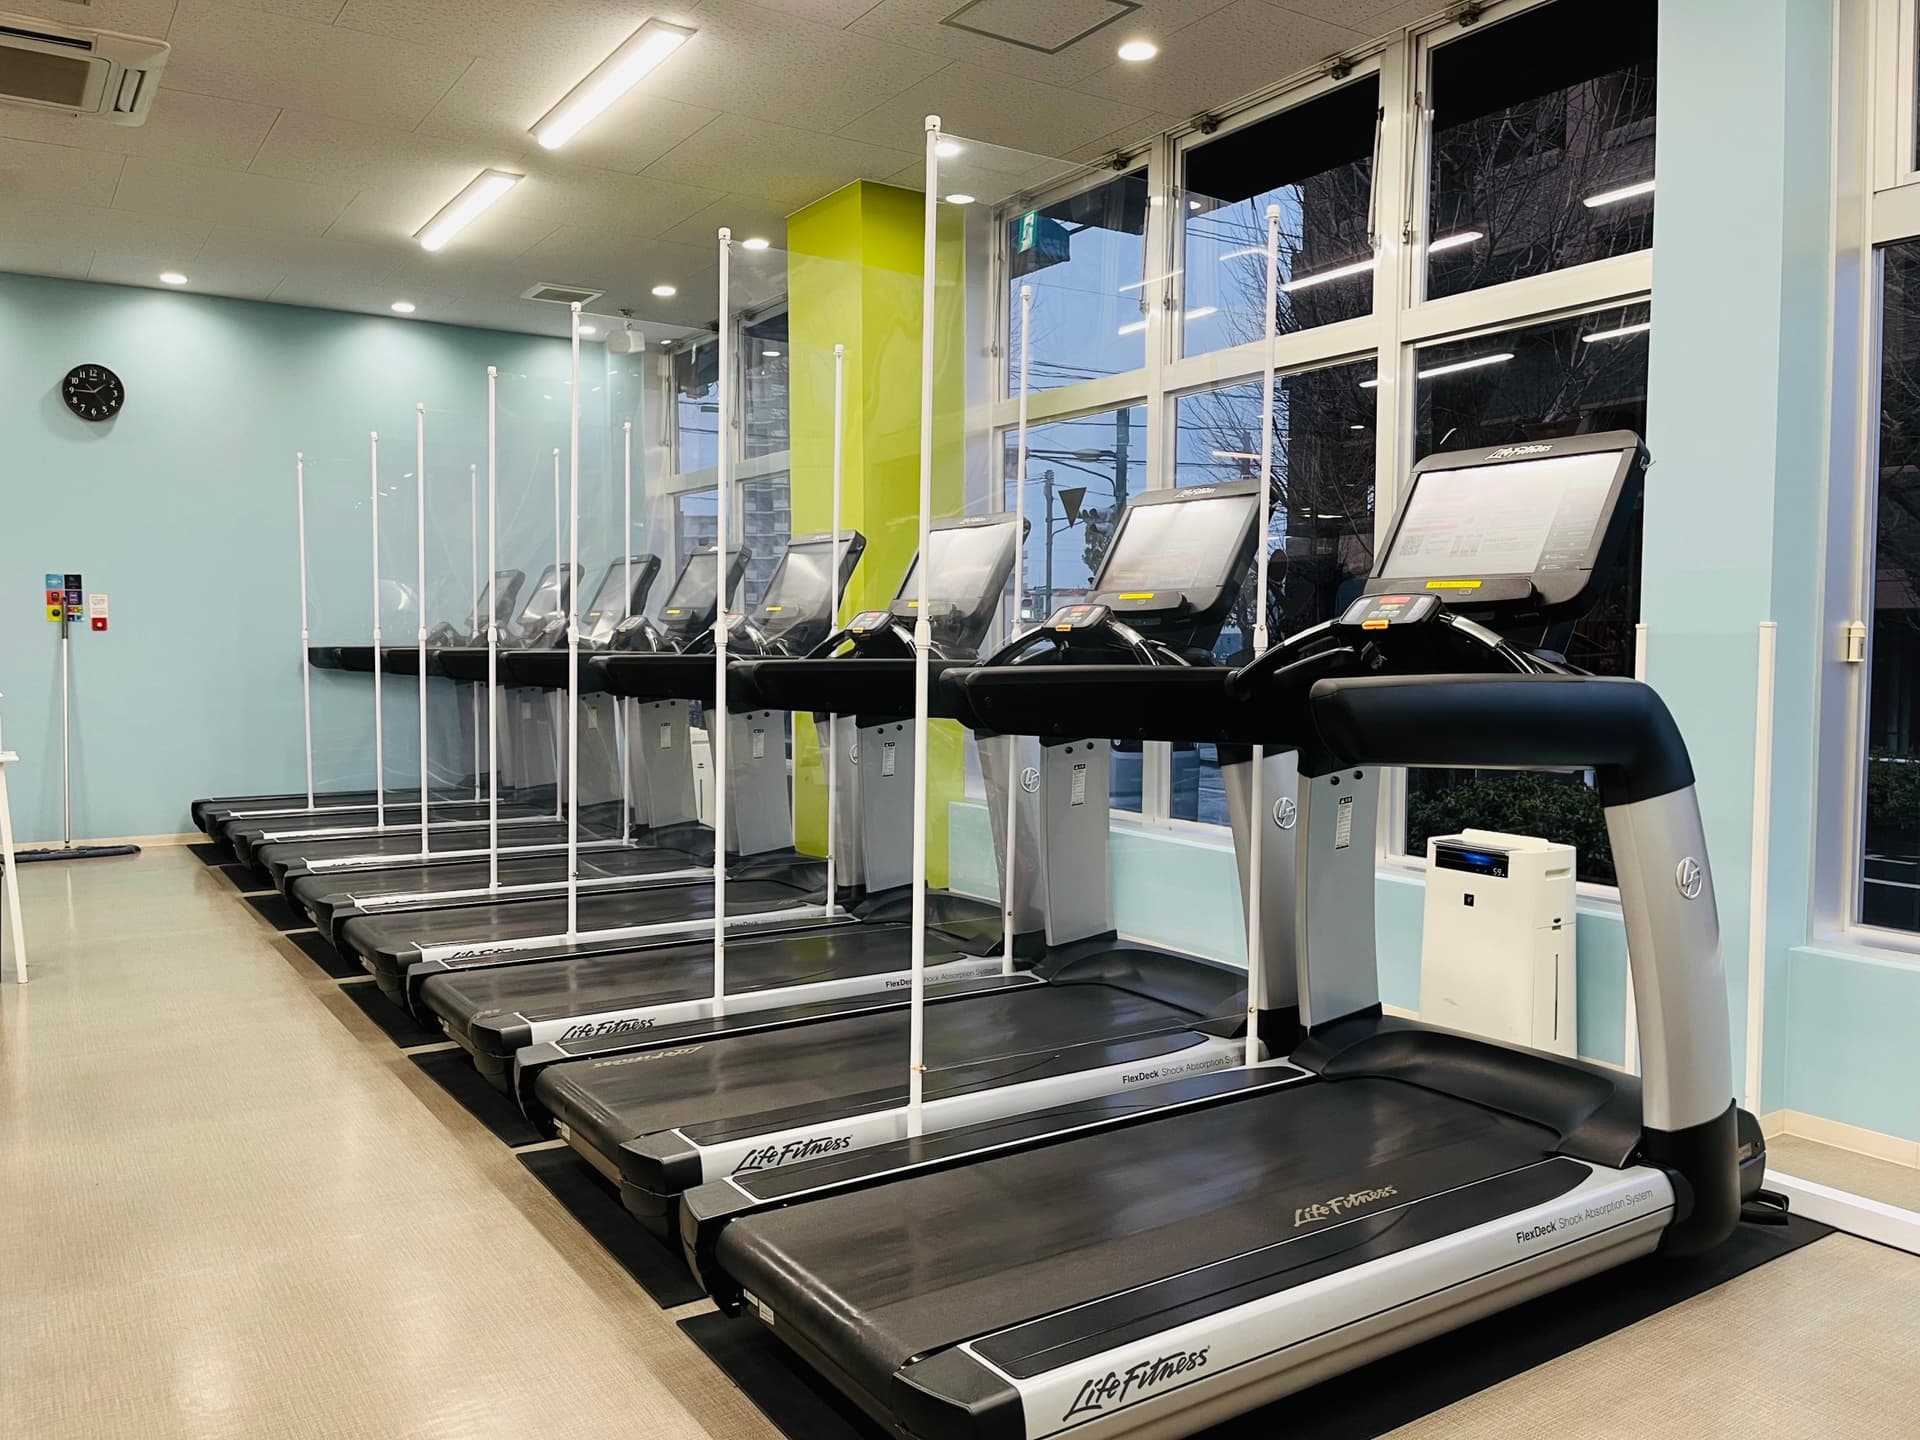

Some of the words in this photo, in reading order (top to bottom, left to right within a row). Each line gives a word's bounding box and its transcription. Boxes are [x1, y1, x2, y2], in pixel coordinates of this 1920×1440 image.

[885, 979, 912, 988] FlexDec
[1122, 1070, 1159, 1084] FlexDeck
[1161, 1065, 1185, 1077] Shock
[1186, 1056, 1224, 1071] Absorption
[1516, 1220, 1557, 1244] FlexDeck
[1558, 1211, 1584, 1230] Shock
[1584, 1200, 1626, 1220] Absorption
[1626, 1189, 1653, 1207] System
